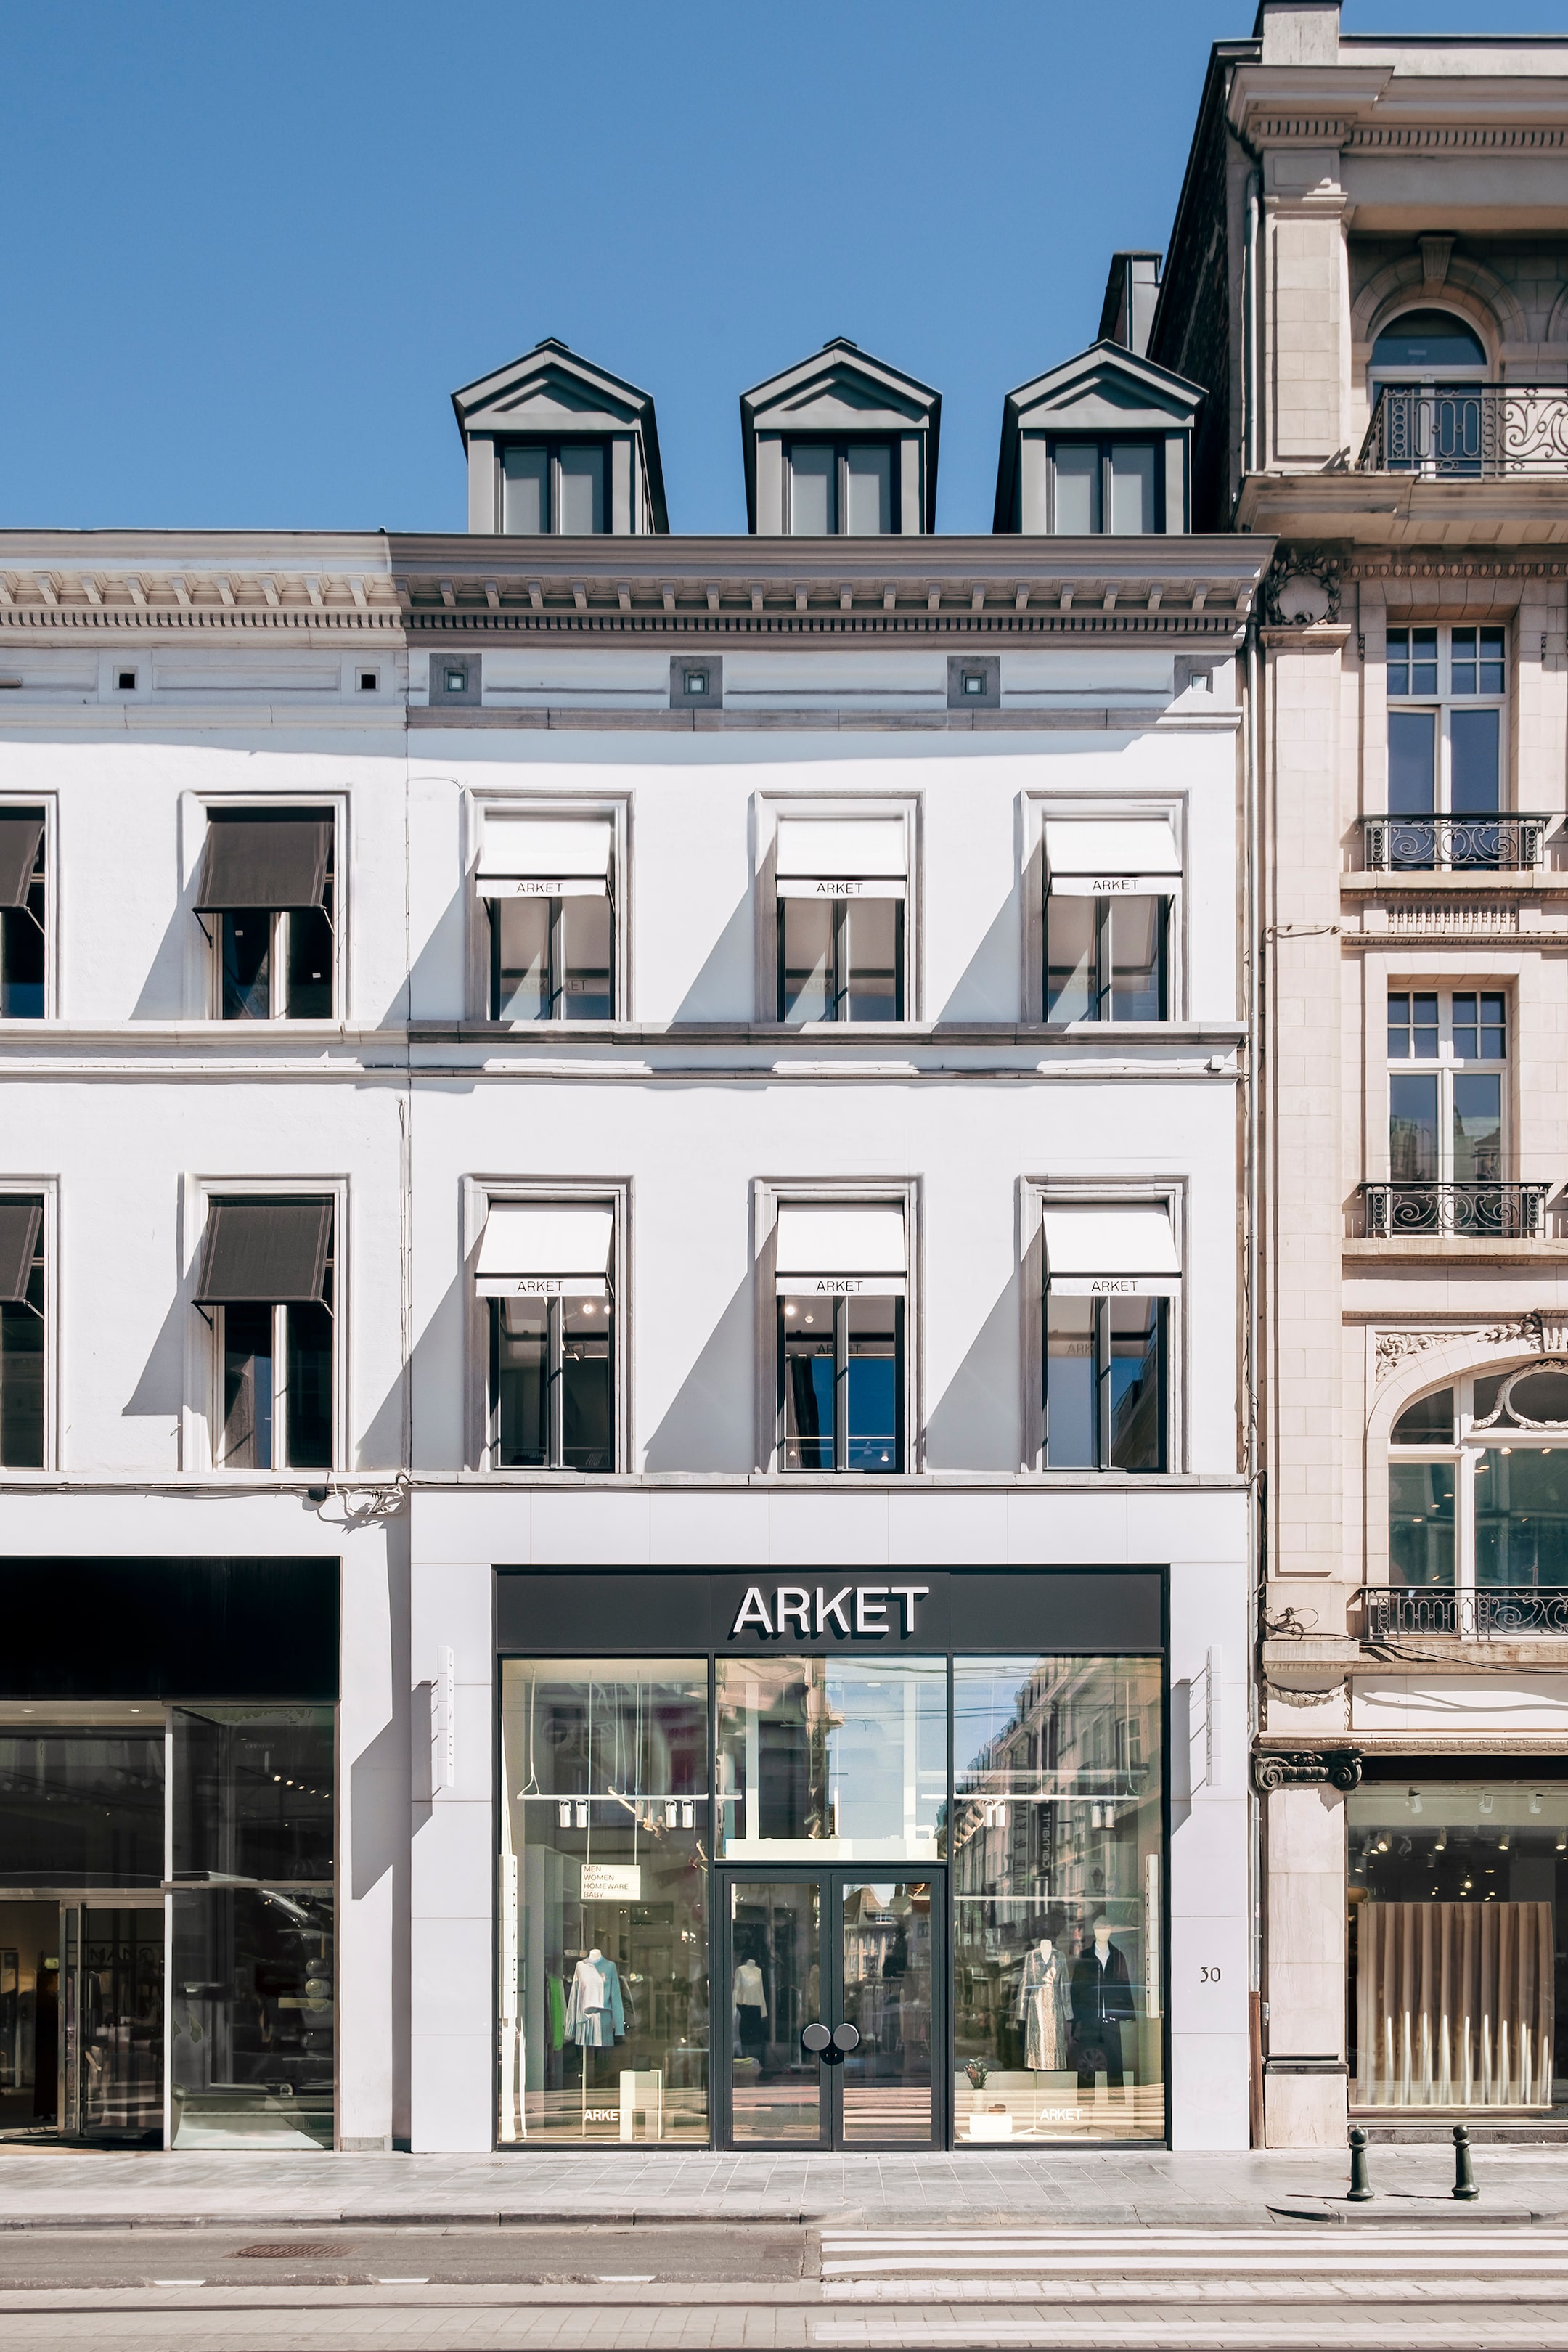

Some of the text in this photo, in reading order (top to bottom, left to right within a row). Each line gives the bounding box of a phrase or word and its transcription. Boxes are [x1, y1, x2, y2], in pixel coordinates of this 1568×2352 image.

[516, 883, 564, 893] ARKET
[816, 883, 863, 894] ARKET
[1092, 879, 1139, 891] ARKET
[516, 1281, 564, 1292] ARKET
[816, 1281, 863, 1291] ARKET
[1091, 1281, 1138, 1291] ARKET
[732, 1586, 930, 1633] ARKET
[1200, 1967, 1221, 1983] 30
[584, 2108, 628, 2121] ARKET
[1040, 2107, 1084, 2120] ARKET
